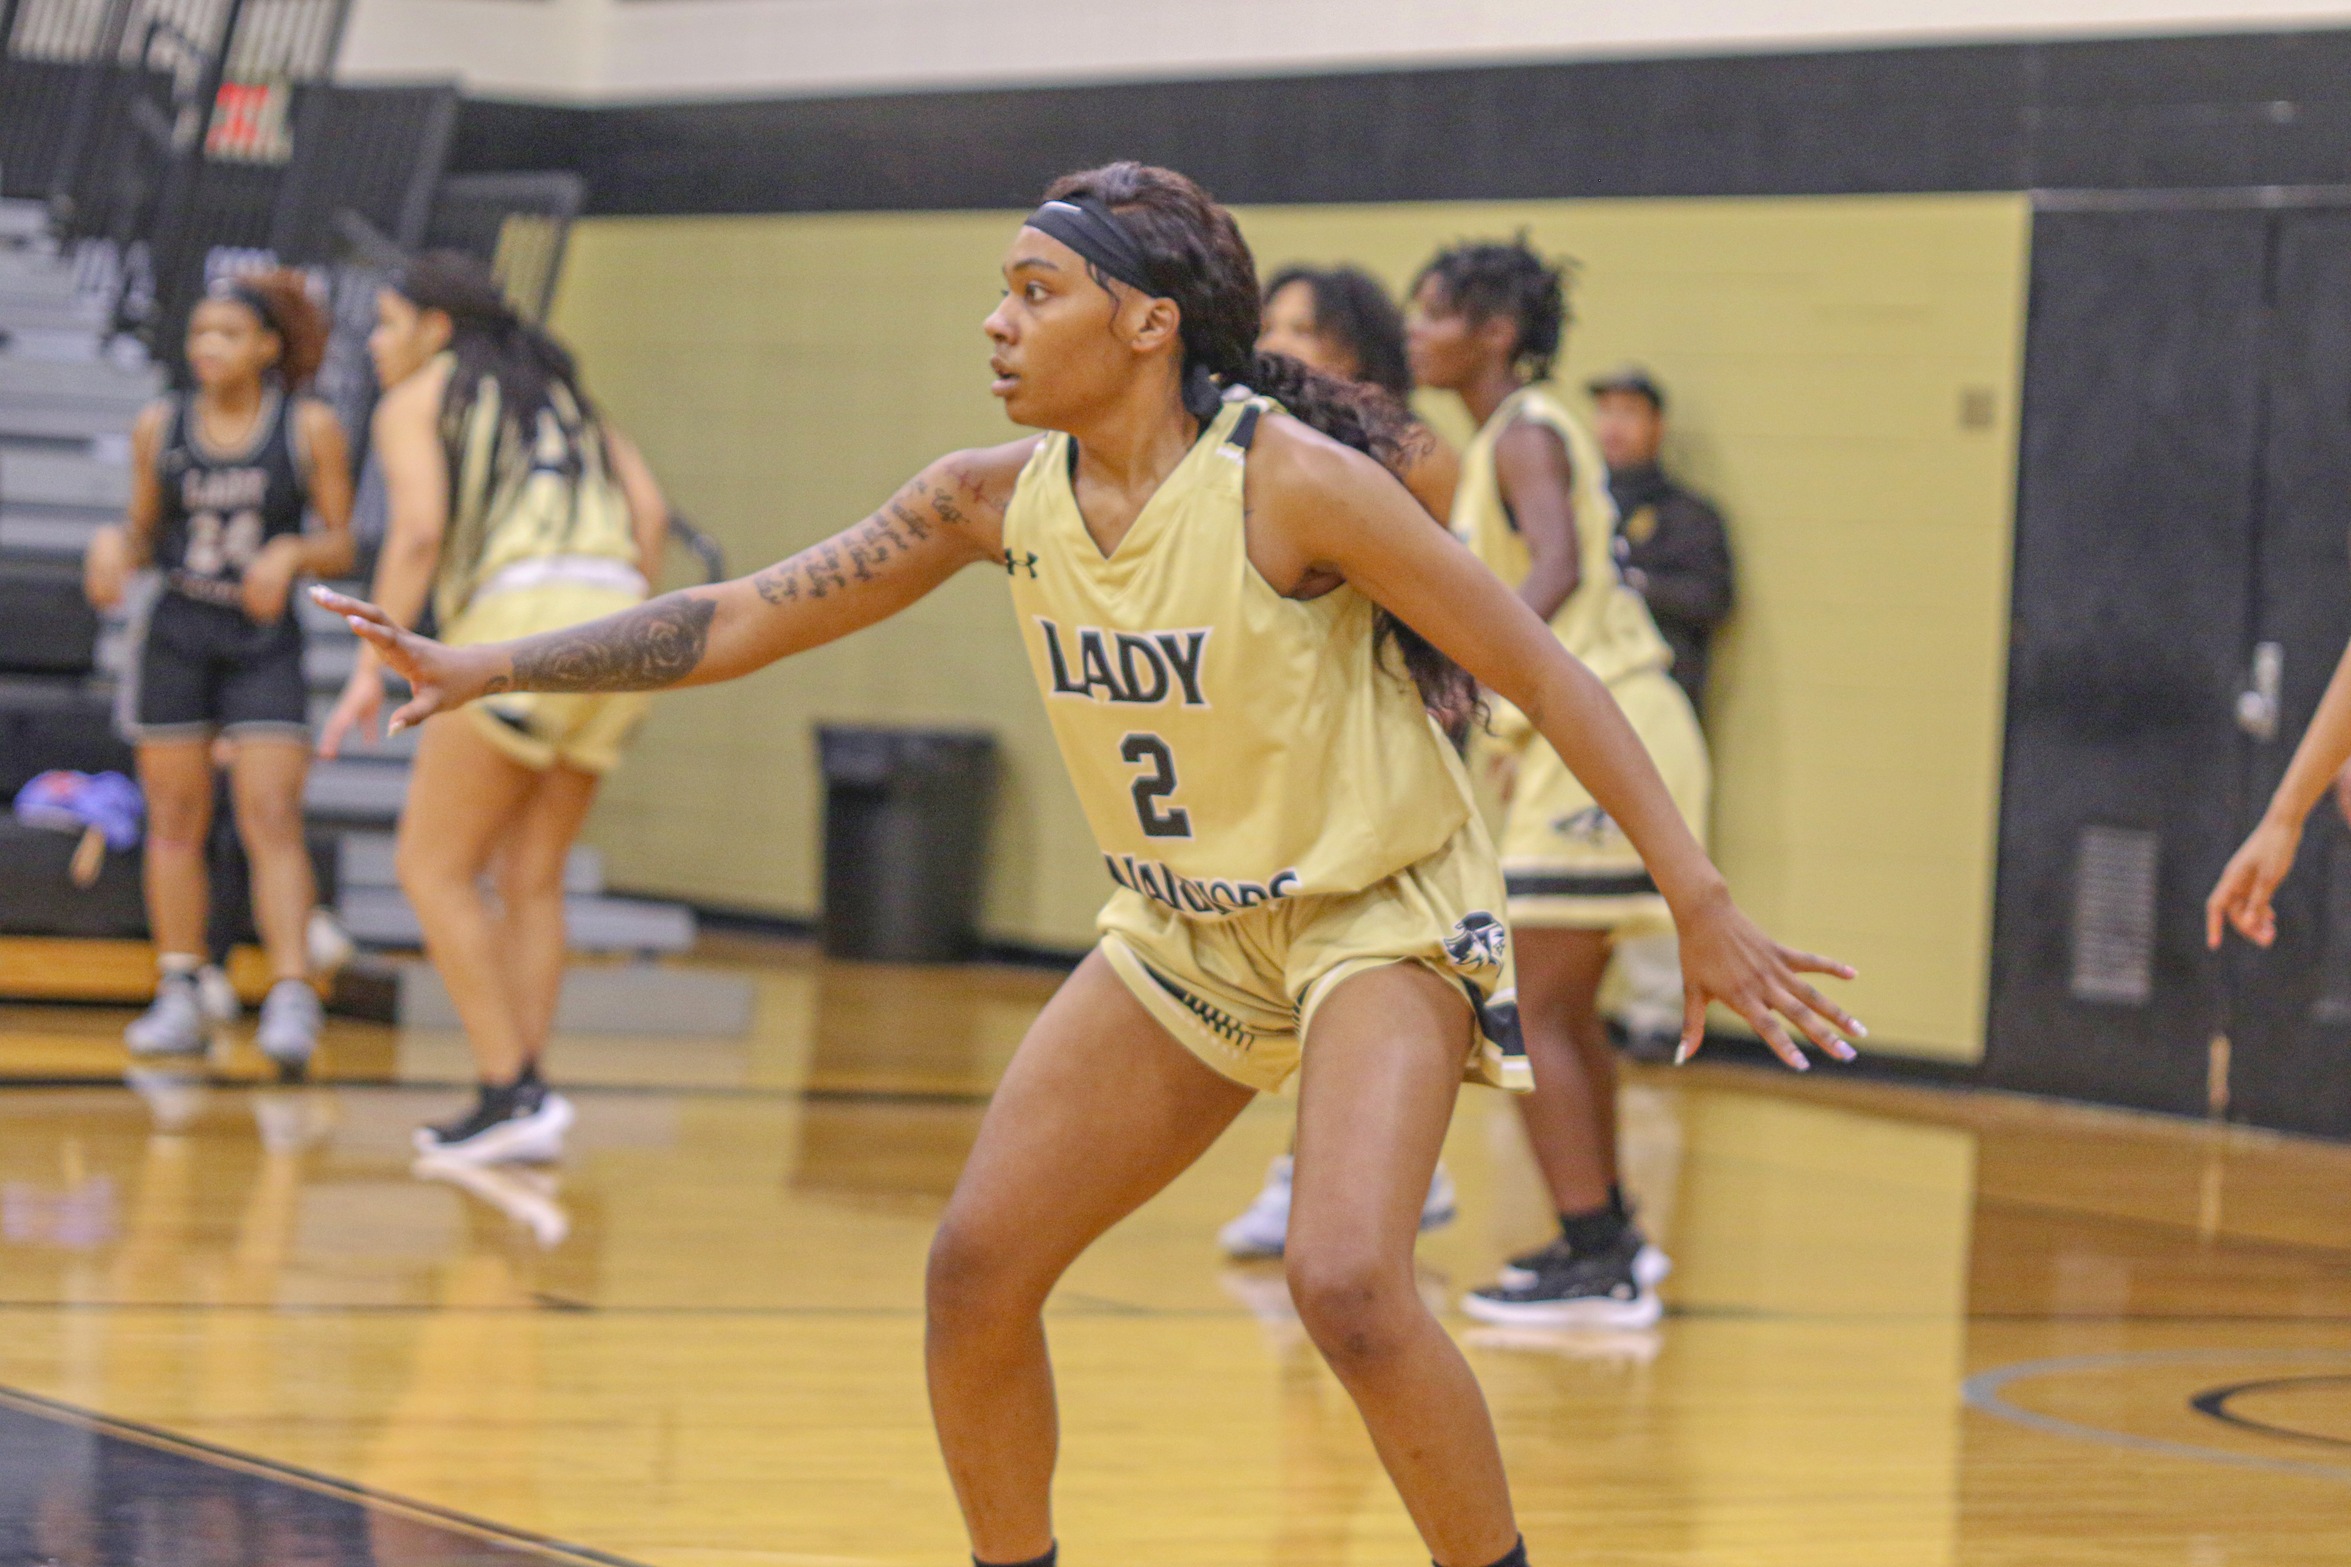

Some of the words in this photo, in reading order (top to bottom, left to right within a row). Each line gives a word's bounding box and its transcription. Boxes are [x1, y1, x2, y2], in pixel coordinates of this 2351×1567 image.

[1036, 617, 1212, 708] LADY
[1118, 731, 1195, 841] 2
[1102, 852, 1300, 916] WAORS
